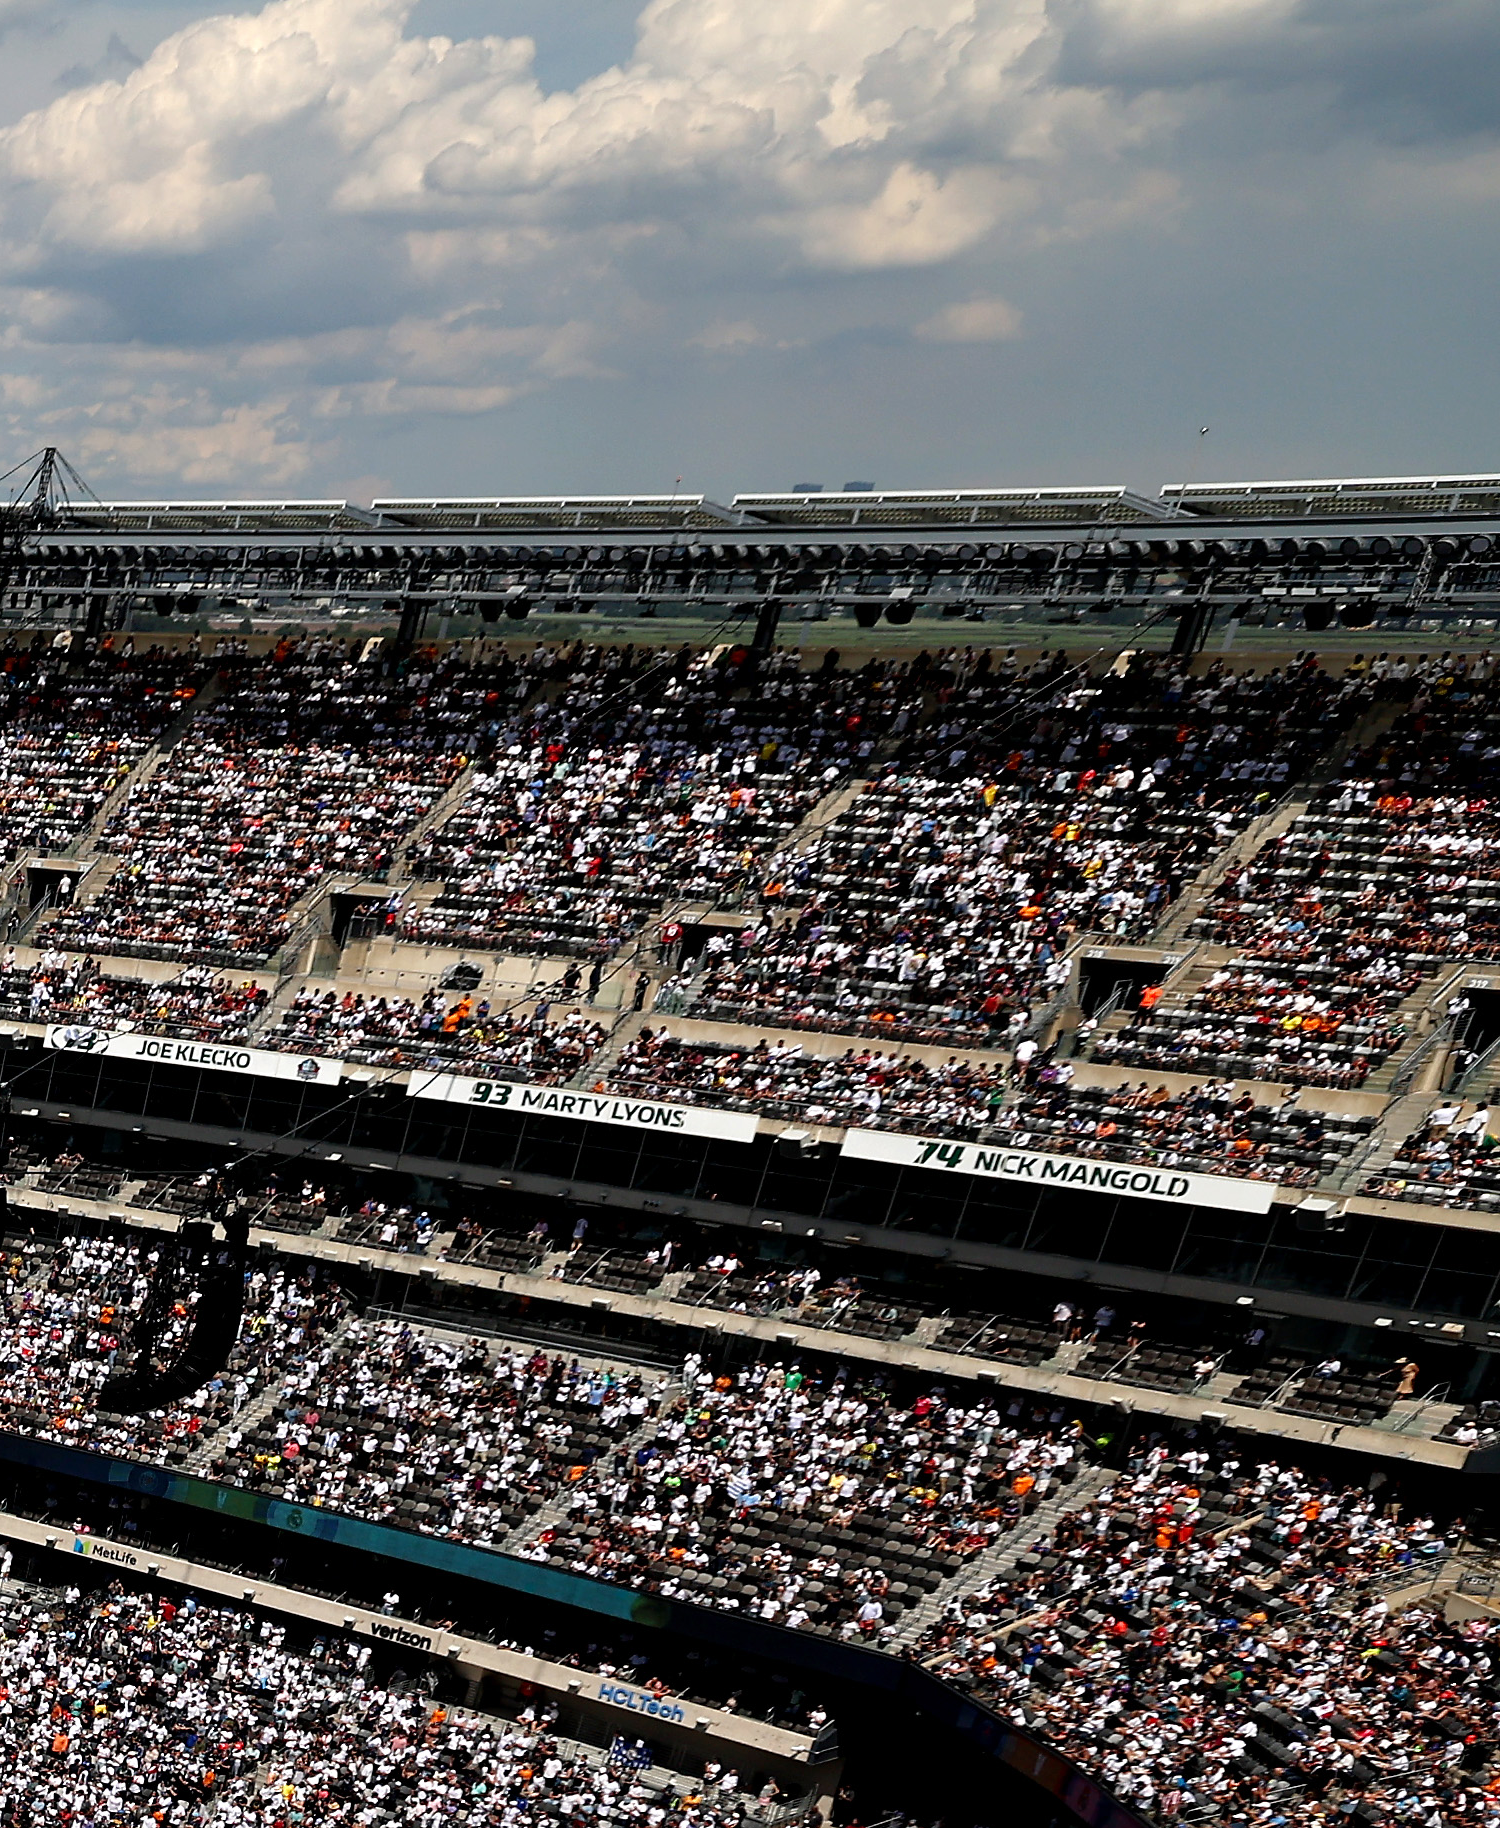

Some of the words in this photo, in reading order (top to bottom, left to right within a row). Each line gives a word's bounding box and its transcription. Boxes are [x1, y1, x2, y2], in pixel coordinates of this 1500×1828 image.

[135, 1040, 172, 1060] JOE
[174, 1040, 251, 1069] KLECKO
[469, 1082, 513, 1105] 93
[521, 1089, 610, 1117] MARTY
[610, 1102, 688, 1129] LYONS
[912, 1140, 964, 1169] 74
[974, 1151, 1038, 1178] NICK
[1039, 1161, 1190, 1198] MANGOLD
[91, 1544, 137, 1566] MetLife
[371, 1622, 432, 1650] verizon
[598, 1683, 685, 1723] HCLTech
